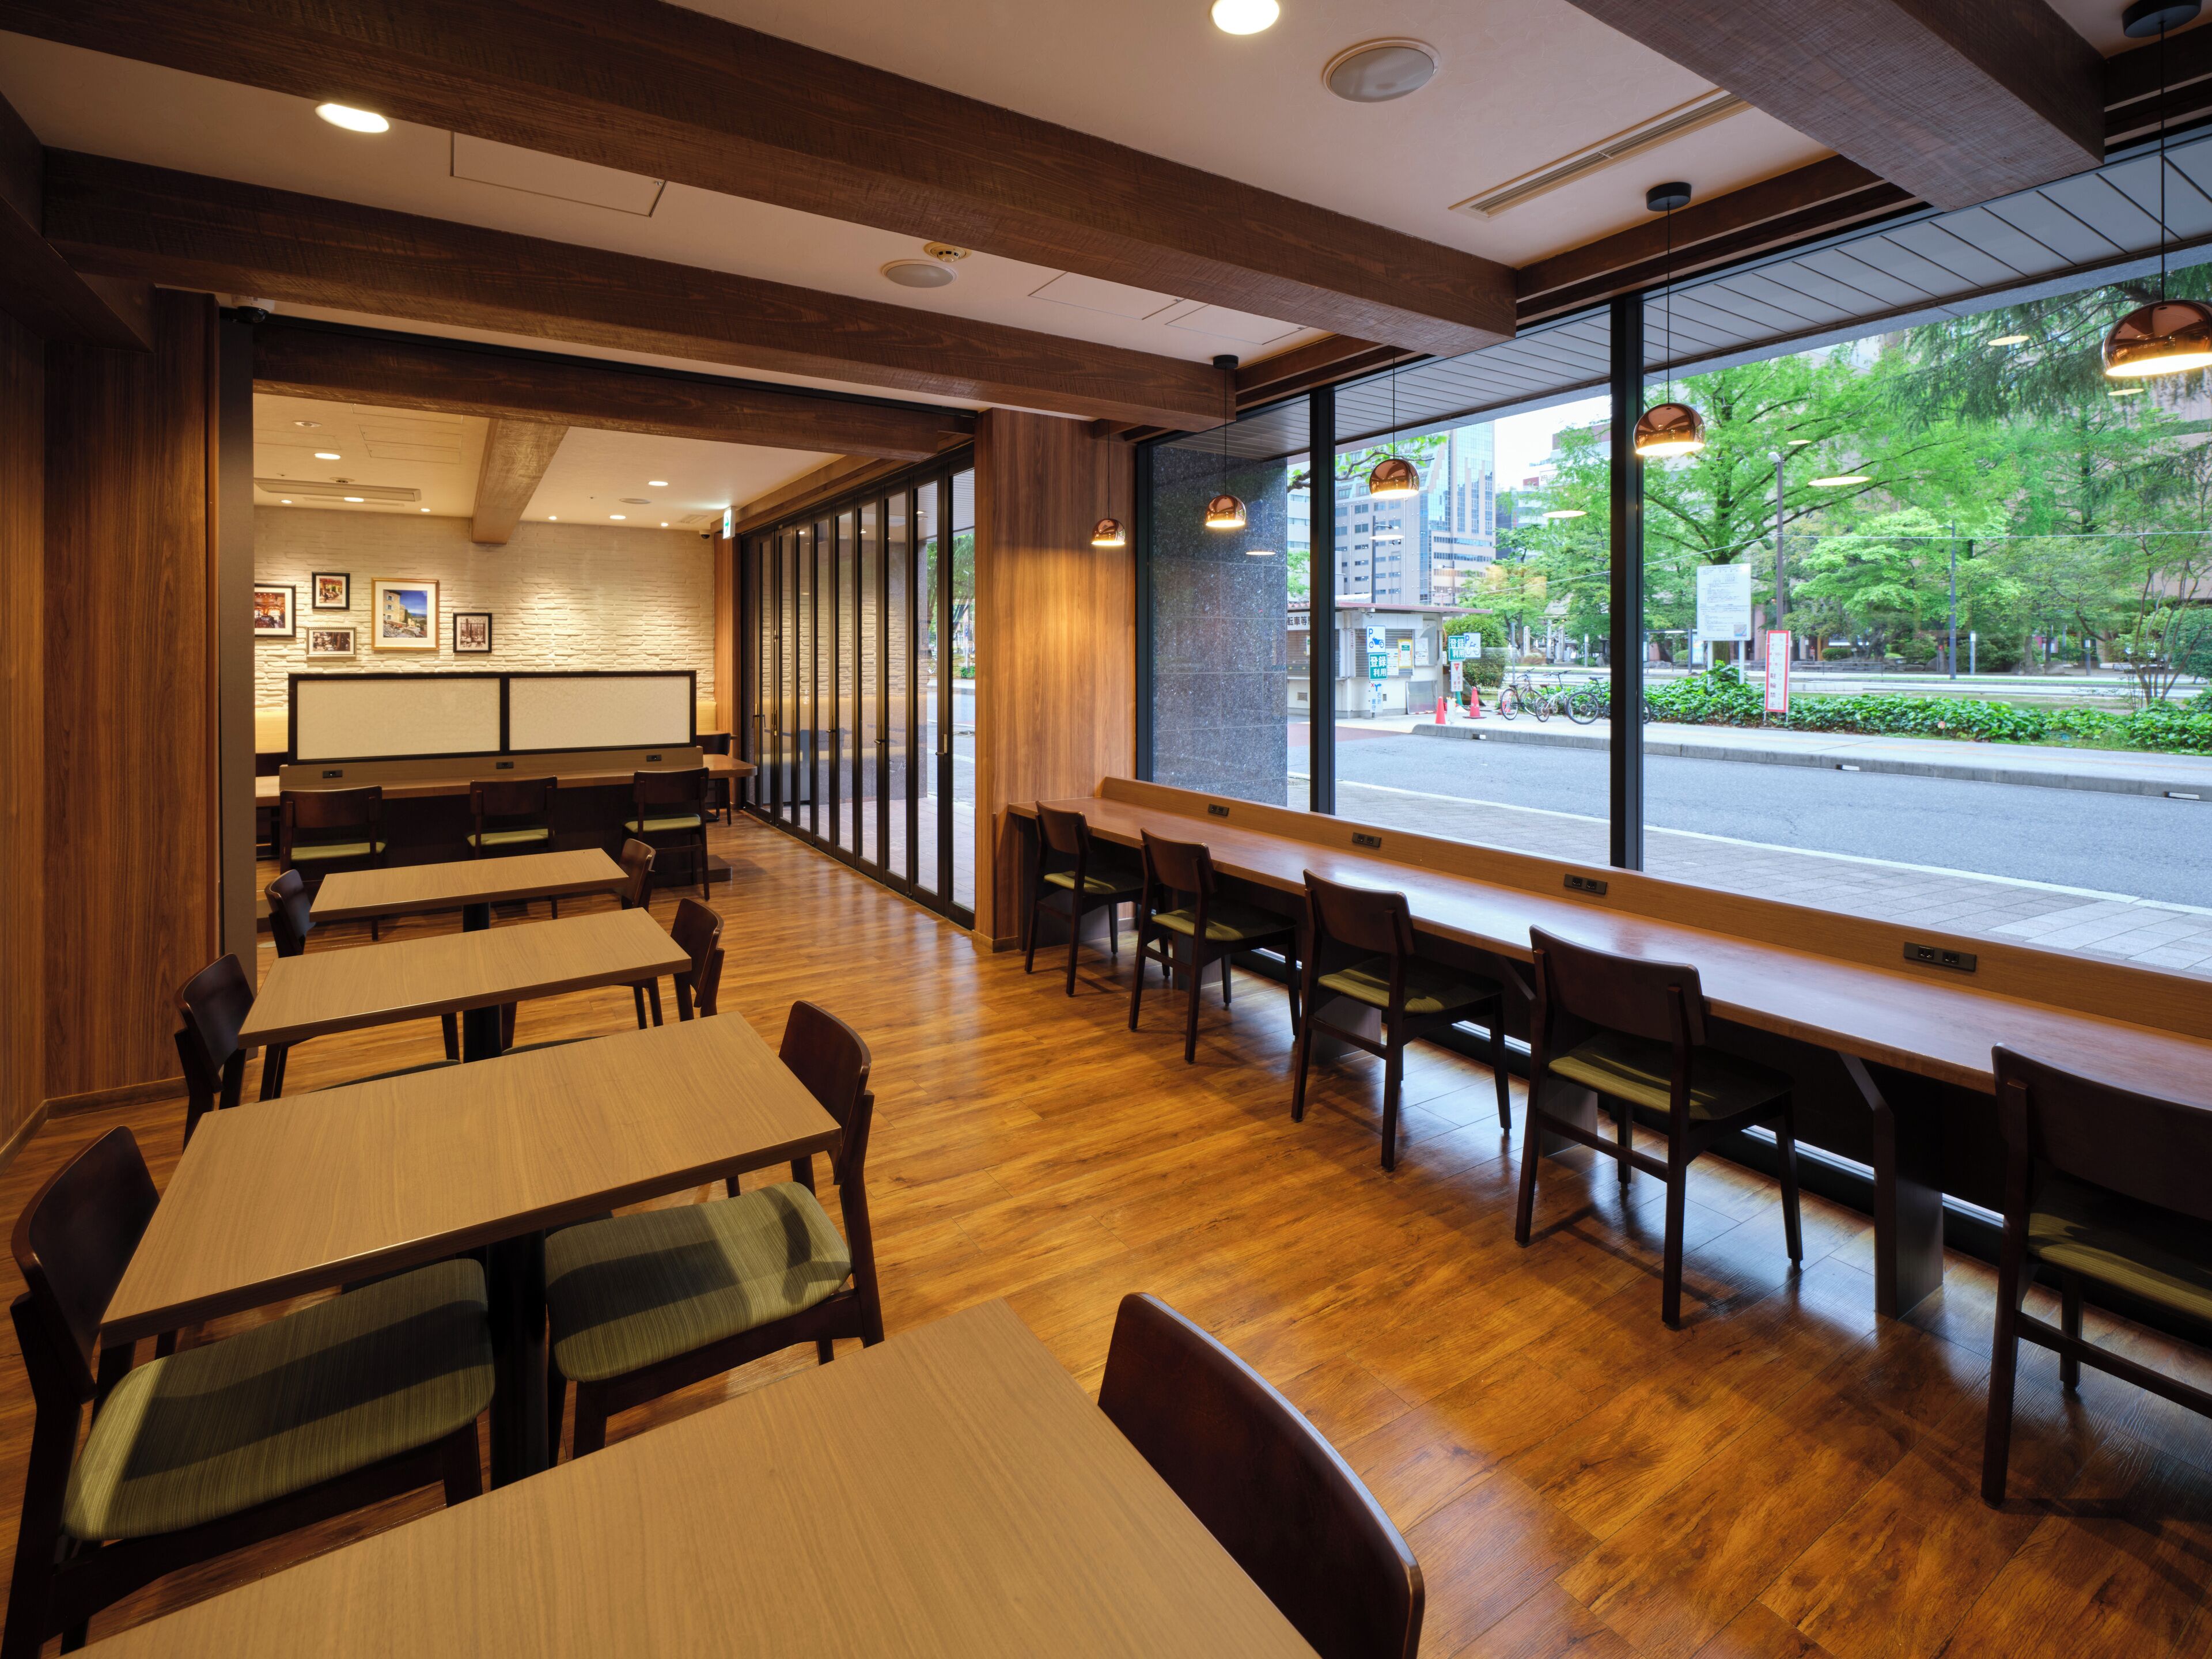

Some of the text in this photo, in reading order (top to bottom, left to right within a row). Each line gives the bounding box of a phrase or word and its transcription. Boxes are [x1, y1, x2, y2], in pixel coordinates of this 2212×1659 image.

[1369, 628, 1373, 637] P
[1450, 638, 1464, 649] 登録
[1465, 635, 1470, 644] P
[1453, 649, 1464, 658] 利用
[1370, 656, 1387, 668] 登録
[1373, 668, 1387, 677] 利用
